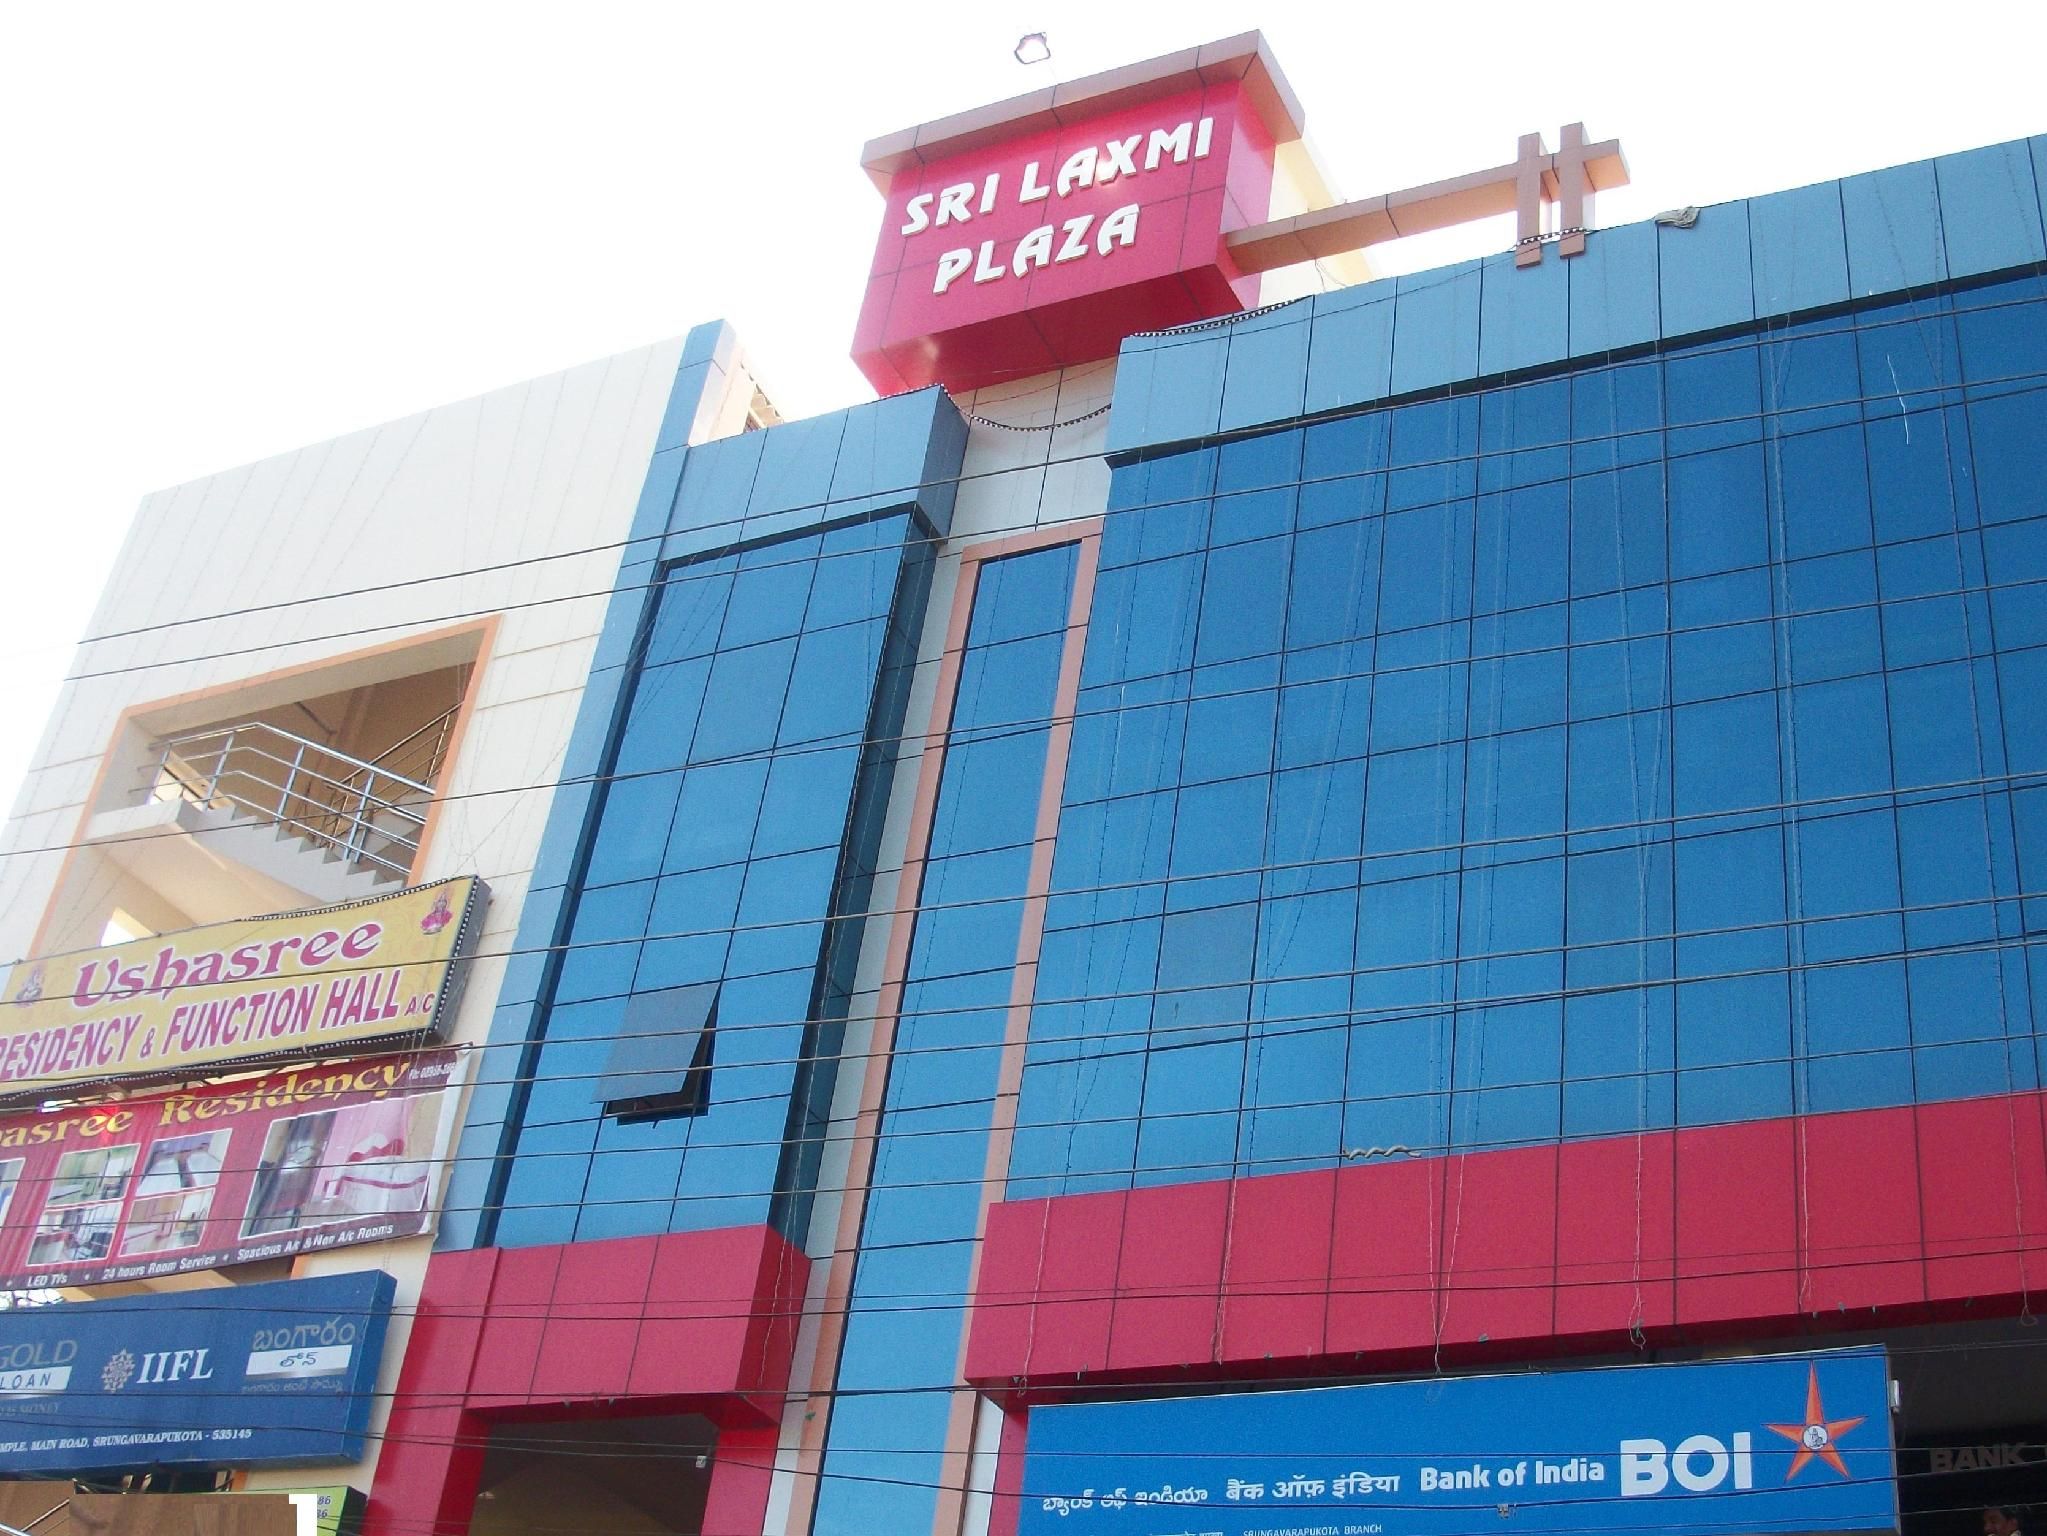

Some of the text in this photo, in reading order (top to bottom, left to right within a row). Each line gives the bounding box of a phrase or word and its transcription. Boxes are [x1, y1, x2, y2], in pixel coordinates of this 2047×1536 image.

[901, 117, 1214, 236] SRI LAXMI
[932, 203, 1140, 295] PLAZA
[72, 922, 381, 1008] Ushasree
[140, 1027, 156, 1059] &
[161, 984, 318, 1055] FUNCTION
[320, 970, 401, 1030] HALL
[404, 992, 434, 1017] A/C
[0, 1061, 411, 1148] asree Residency
[27, 1273, 47, 1287] LED
[102, 1267, 114, 1280] 24
[118, 1264, 145, 1277] hours
[148, 1261, 177, 1274] Room
[179, 1254, 216, 1270] Service
[236, 1243, 281, 1261] Spacious
[313, 1234, 334, 1247] Non
[253, 1315, 355, 1351] బంగారం
[136, 1348, 213, 1384] IIFL
[31, 1439, 57, 1451] MAIN
[93, 1431, 203, 1447] SRUNGAVARAPUKOTA
[1930, 1443, 2026, 1473] BANK
[1226, 1478, 1264, 1500] बैंक
[1332, 1471, 1401, 1498] इंडिया
[1420, 1456, 1605, 1491] Bank of India
[1620, 1431, 1753, 1497] BOI
[1344, 1524, 1382, 1534] BRANCH
